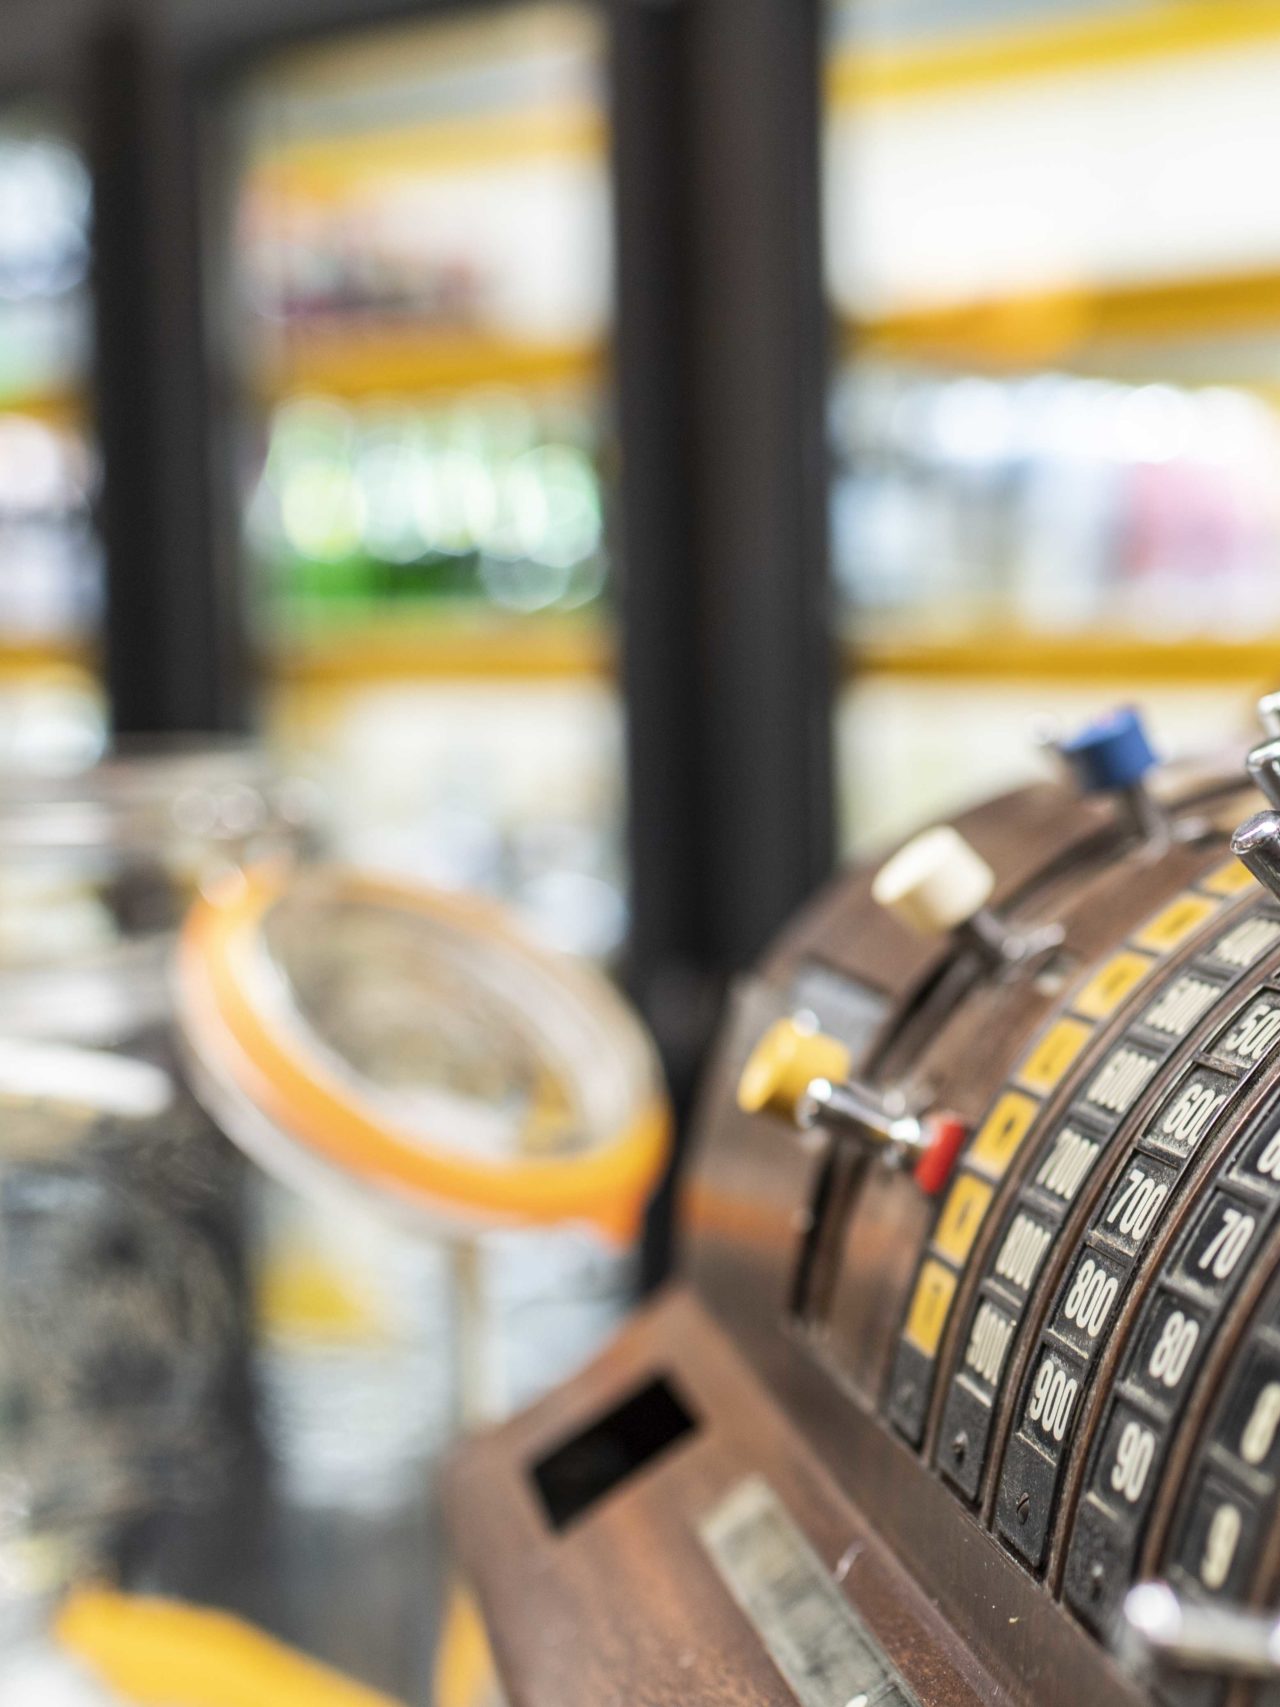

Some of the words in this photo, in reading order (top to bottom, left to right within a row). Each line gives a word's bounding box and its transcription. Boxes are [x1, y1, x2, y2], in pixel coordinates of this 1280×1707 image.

[1106, 1168, 1169, 1242] 700
[1199, 1207, 1256, 1280] 70
[1064, 1258, 1119, 1338] 800
[1148, 1310, 1200, 1389] 80
[1029, 1358, 1079, 1442] 900
[1110, 1421, 1156, 1503] 90
